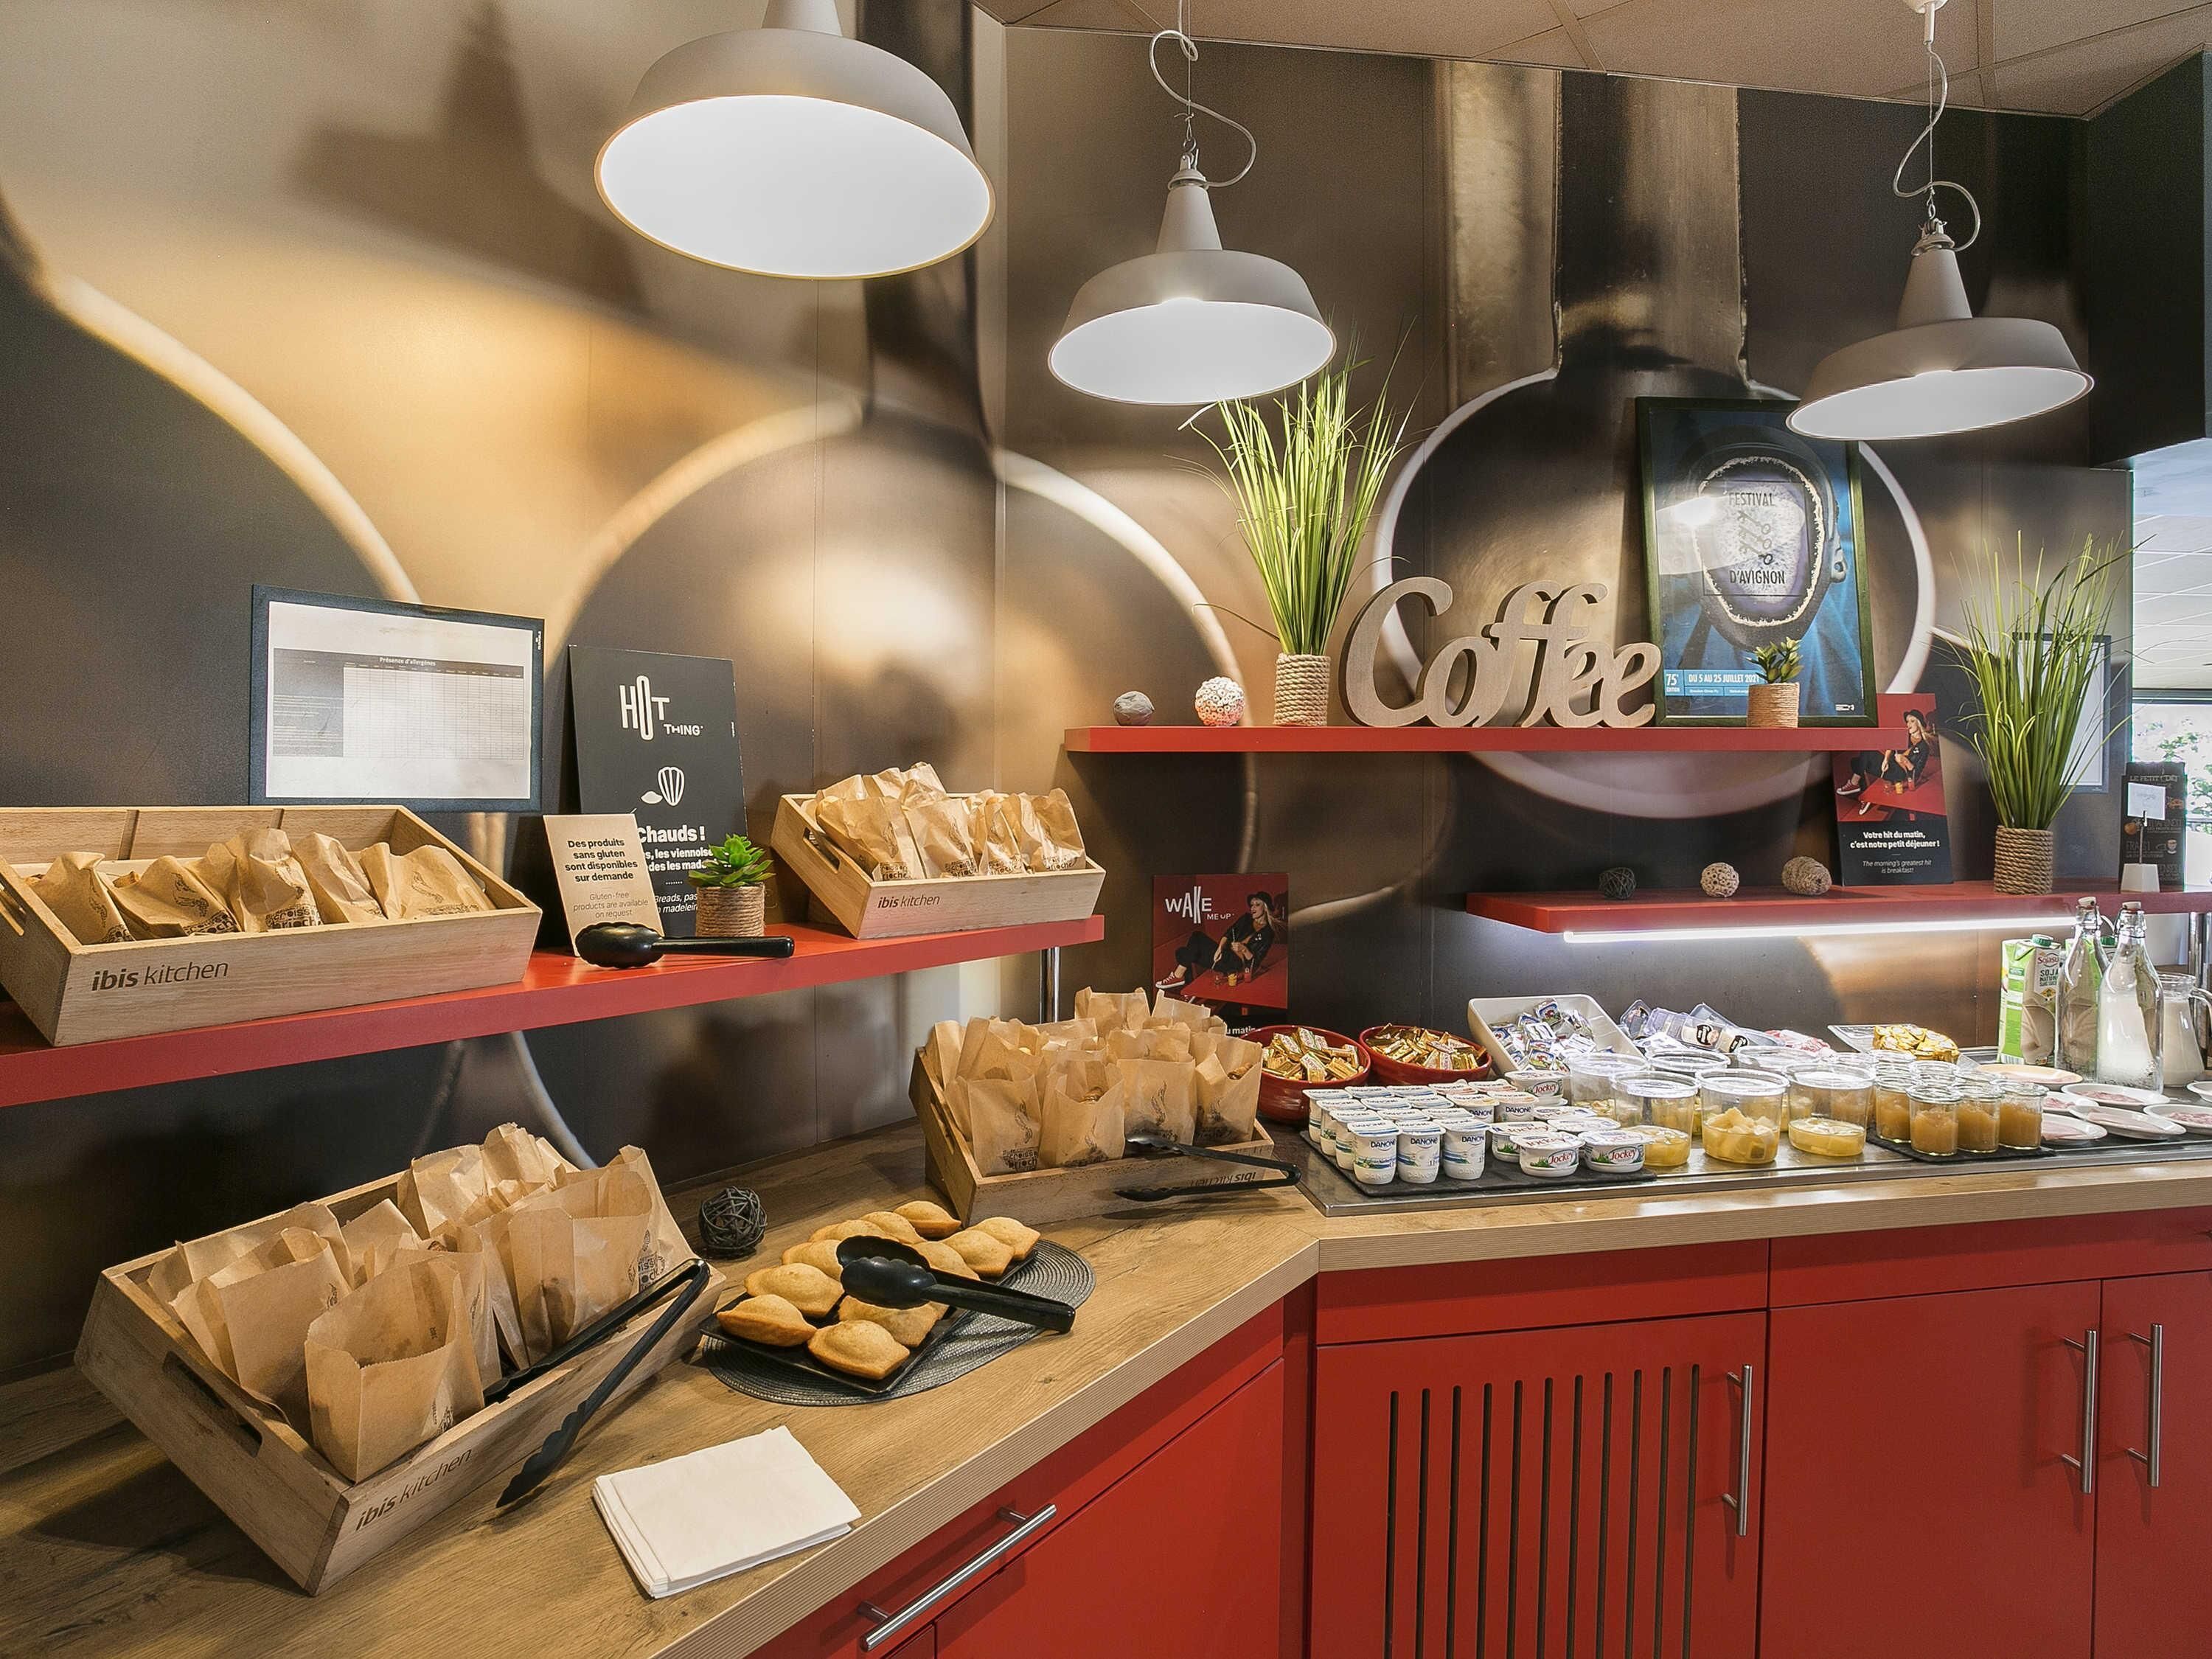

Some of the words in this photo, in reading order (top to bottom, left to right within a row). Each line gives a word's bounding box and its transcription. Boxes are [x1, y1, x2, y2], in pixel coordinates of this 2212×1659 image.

[1728, 493, 1774, 507] FESTIVAL
[1729, 570, 1785, 585] D'AVIGNON
[1338, 577, 1662, 728] Coffee
[619, 675, 670, 740] HOT
[588, 838, 625, 849] produits
[597, 849, 625, 860] gluten
[655, 849, 669, 858] les
[670, 847, 714, 858] viennoise
[587, 860, 639, 871] disponibles
[667, 861, 681, 870] les
[681, 859, 708, 869] mad
[591, 871, 634, 881] demande
[590, 891, 630, 900] Gluten-free
[684, 893, 698, 902] pas
[877, 897, 899, 908] ibis
[900, 894, 940, 907] kitchen
[574, 902, 605, 911] products
[619, 899, 648, 907] available
[1165, 886, 1212, 924] WAKE
[605, 910, 633, 919] request
[2037, 956, 2058, 964] Sojasu
[91, 969, 139, 991] ibis
[144, 961, 229, 986] kitchen
[1534, 1083, 1557, 1093] Jockey
[1550, 1150, 1574, 1164] Jockey
[1610, 1150, 1637, 1161] Jockey
[355, 1495, 397, 1531] ibis
[399, 1449, 472, 1503] kitchen
